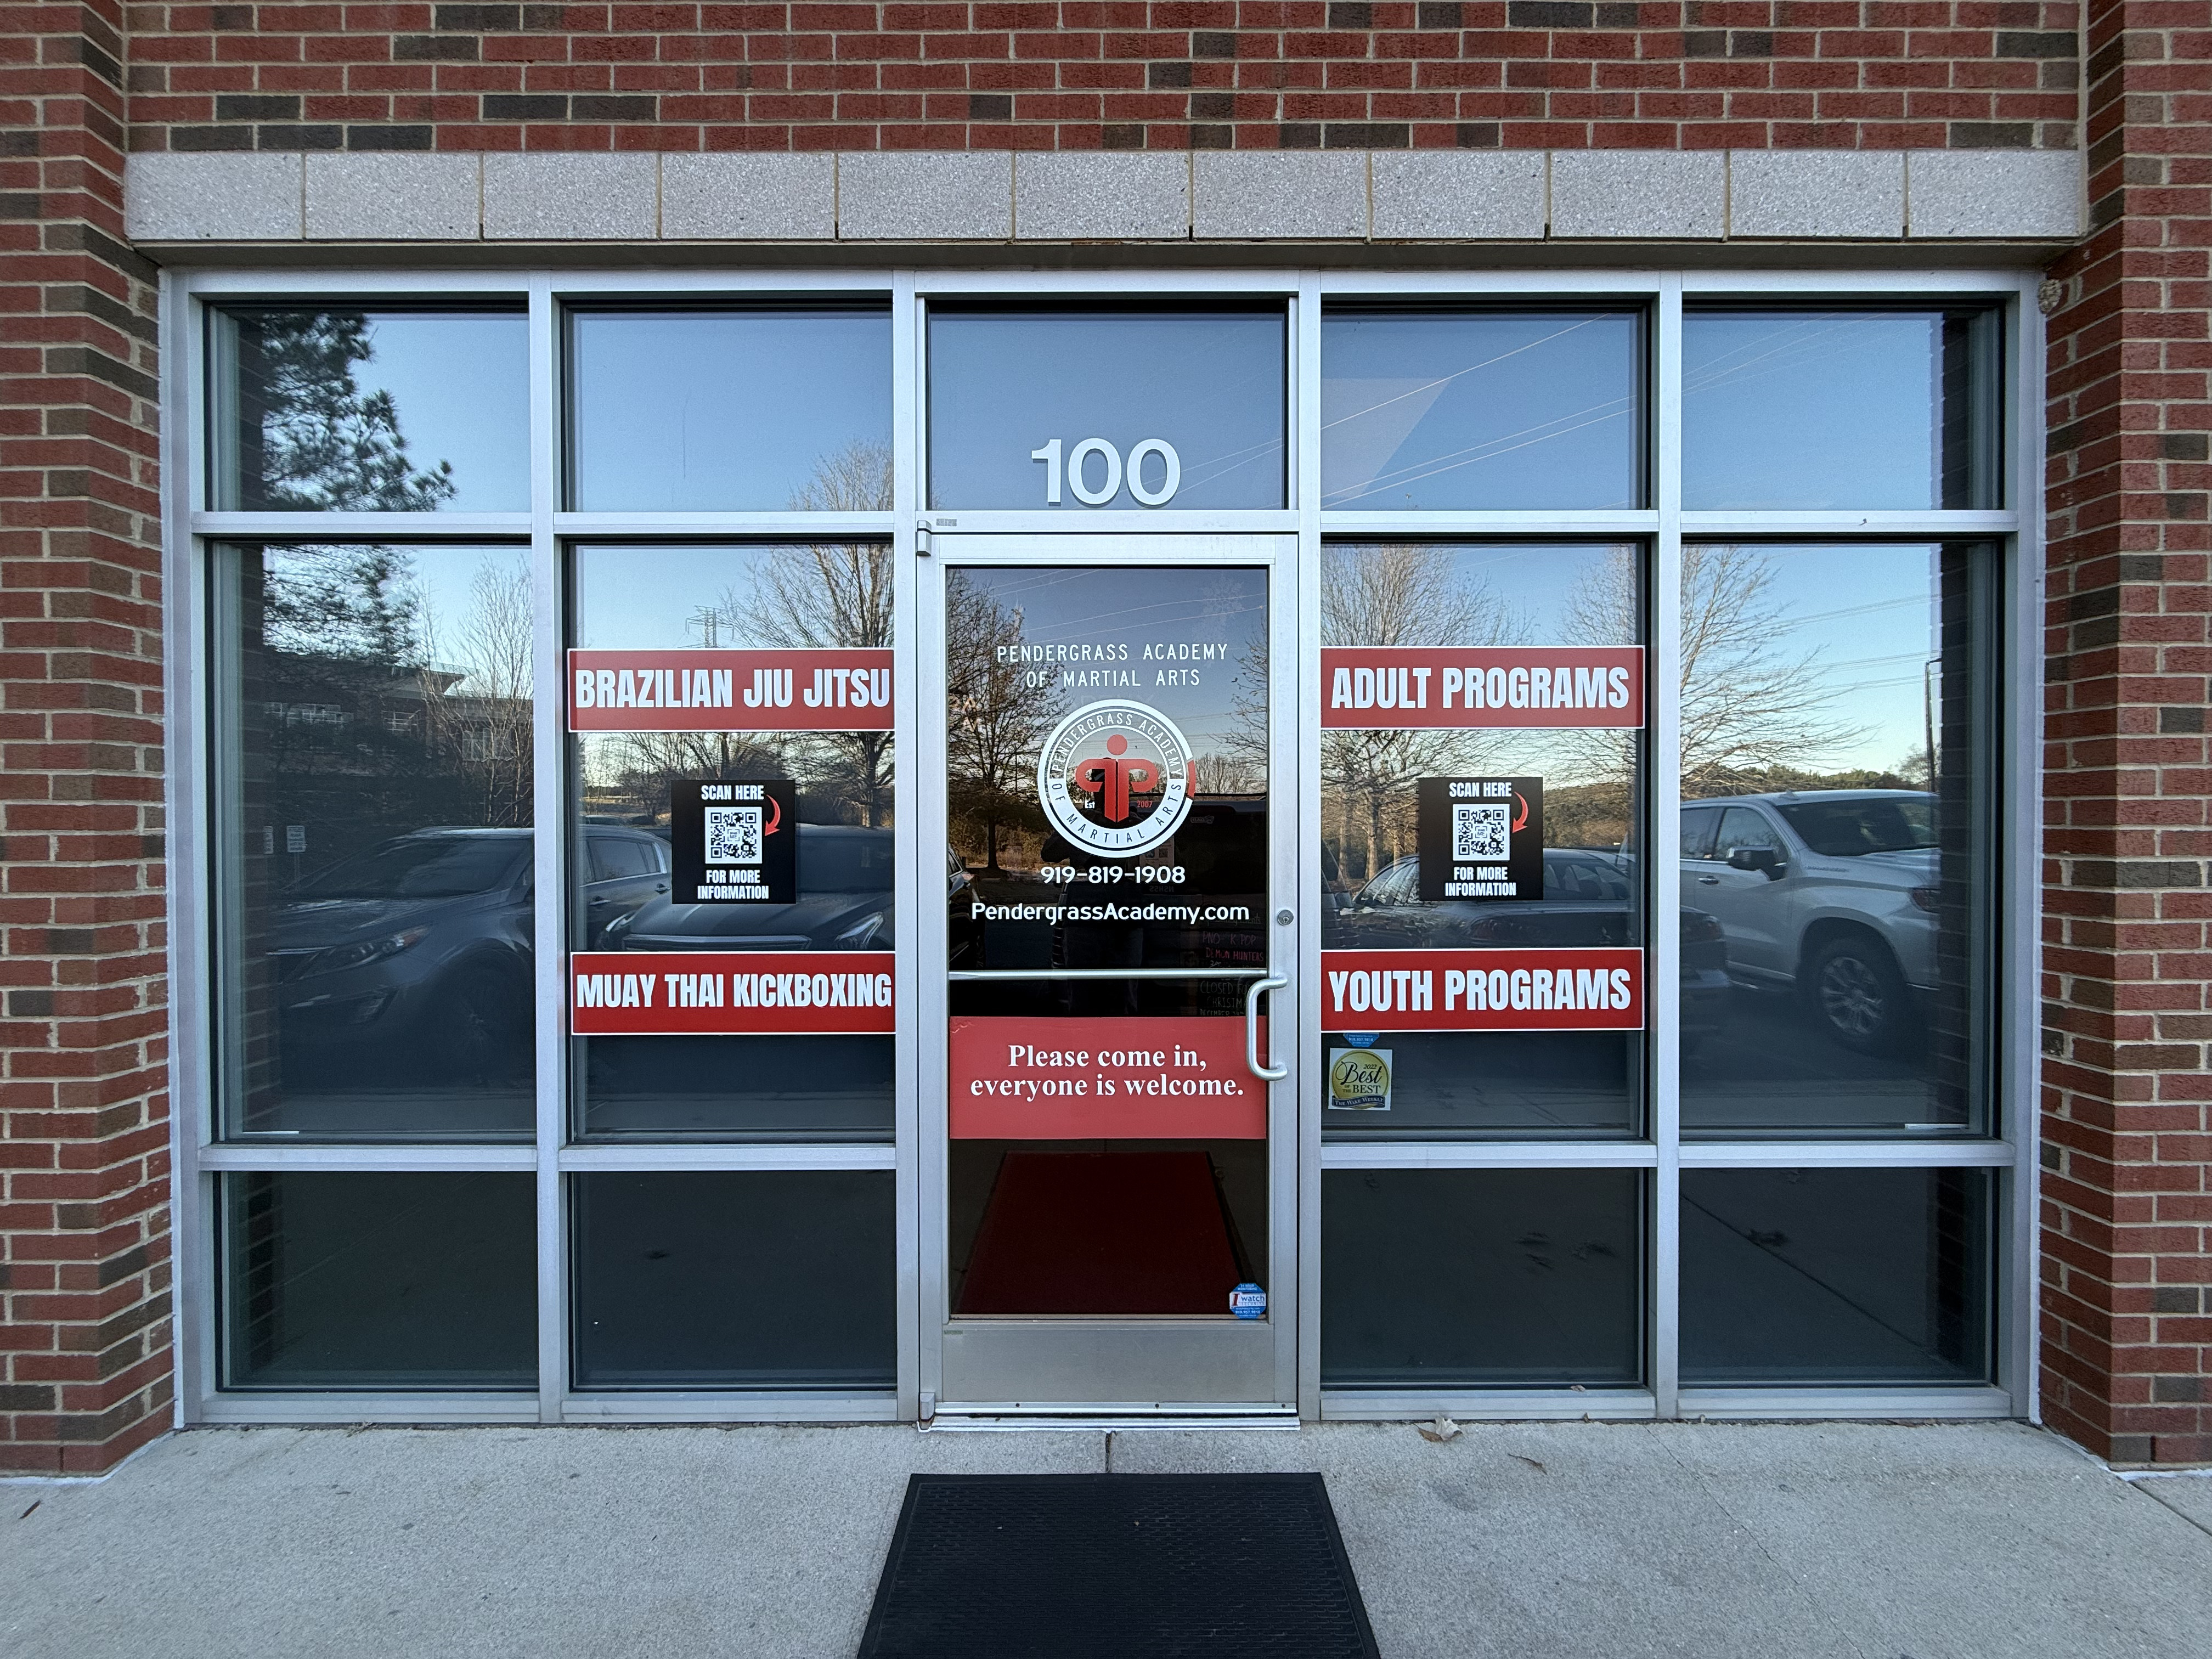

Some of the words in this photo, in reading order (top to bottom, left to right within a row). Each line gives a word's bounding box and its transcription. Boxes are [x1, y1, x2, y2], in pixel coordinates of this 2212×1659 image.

[1031, 437, 1182, 507] 100
[997, 644, 1128, 662] PENDERGRASS
[1143, 644, 1228, 660] ACADEMY
[575, 669, 732, 708] BRAZILIAN
[743, 669, 793, 708] JIU
[803, 668, 890, 708] JITSU
[1026, 671, 1048, 688] OF
[1063, 670, 1141, 687] MARTIAL
[1155, 669, 1200, 686] ARTS
[1331, 668, 1431, 709] ADULT
[1442, 667, 1629, 709] PROGRAMS
[1051, 713, 1133, 771] PENDERGRASS
[1138, 713, 1183, 779] ACADEMY
[701, 785, 732, 800] SCAN
[735, 785, 764, 800] HERE
[1449, 782, 1480, 798] SCAN
[1483, 782, 1512, 797] HERE
[1052, 782, 1066, 803] OF
[1066, 814, 1146, 844] MARTIAL
[1157, 783, 1182, 827] ARTS
[1085, 800, 1096, 809] Est
[1136, 800, 1153, 808] 2007
[706, 870, 726, 884] FOR
[729, 870, 760, 884] MORE
[1040, 866, 1186, 884] 919-819-1908
[1453, 866, 1474, 881] FOR
[1476, 866, 1508, 881] MORE
[697, 885, 769, 899] INFORMATION
[1445, 882, 1516, 896] INFORMATION
[972, 902, 1249, 926] PendergrassAcademy.com
[1233, 951, 1264, 962] HUNTERS
[577, 974, 657, 1008] MUAY
[664, 974, 724, 1007] THAI
[733, 973, 891, 1007] KICKBOXING
[1328, 970, 1432, 1012] YOUTH
[1445, 968, 1631, 1011] PROGRAMS
[1008, 1045, 1089, 1067] Please
[1098, 1051, 1165, 1067] come
[1173, 1044, 1206, 1071] in,
[1335, 1061, 1383, 1085] Best
[970, 1080, 1087, 1102] everyone
[1096, 1073, 1115, 1096] is
[1124, 1074, 1243, 1096] welcome.
[1352, 1084, 1381, 1094] BEST
